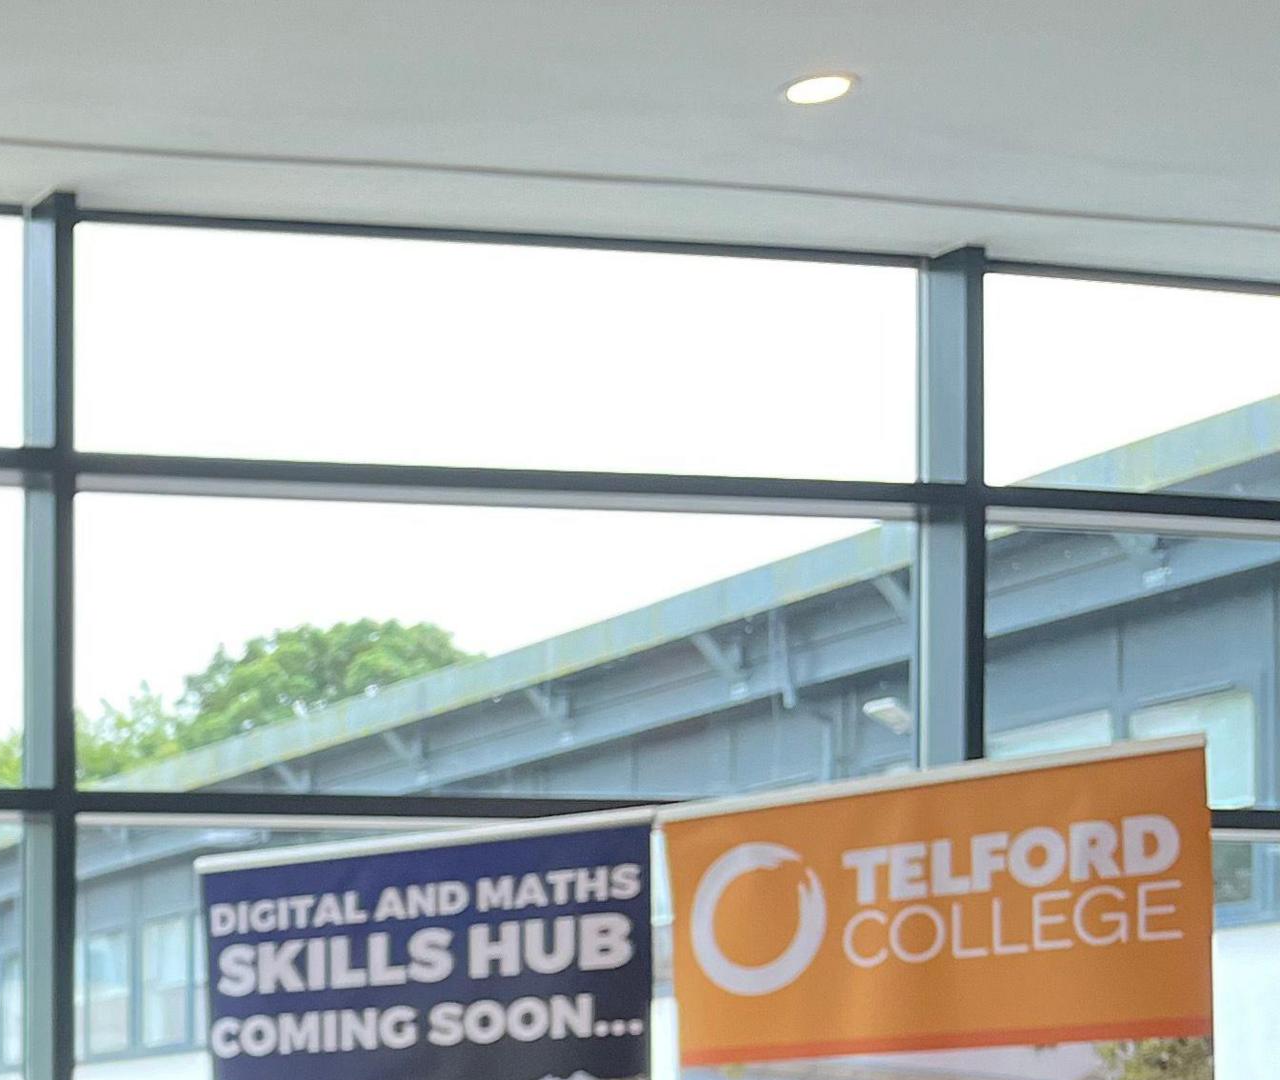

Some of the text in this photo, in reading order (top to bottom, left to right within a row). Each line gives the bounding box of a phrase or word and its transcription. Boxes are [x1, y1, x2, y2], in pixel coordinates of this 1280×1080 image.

[209, 863, 641, 937] DIGITAL AND MATHS
[842, 814, 1181, 903] TELFORD
[217, 912, 633, 997] SKILLS HUB
[842, 879, 1183, 968] COLLEGE
[211, 993, 643, 1058] COMING SOON...
